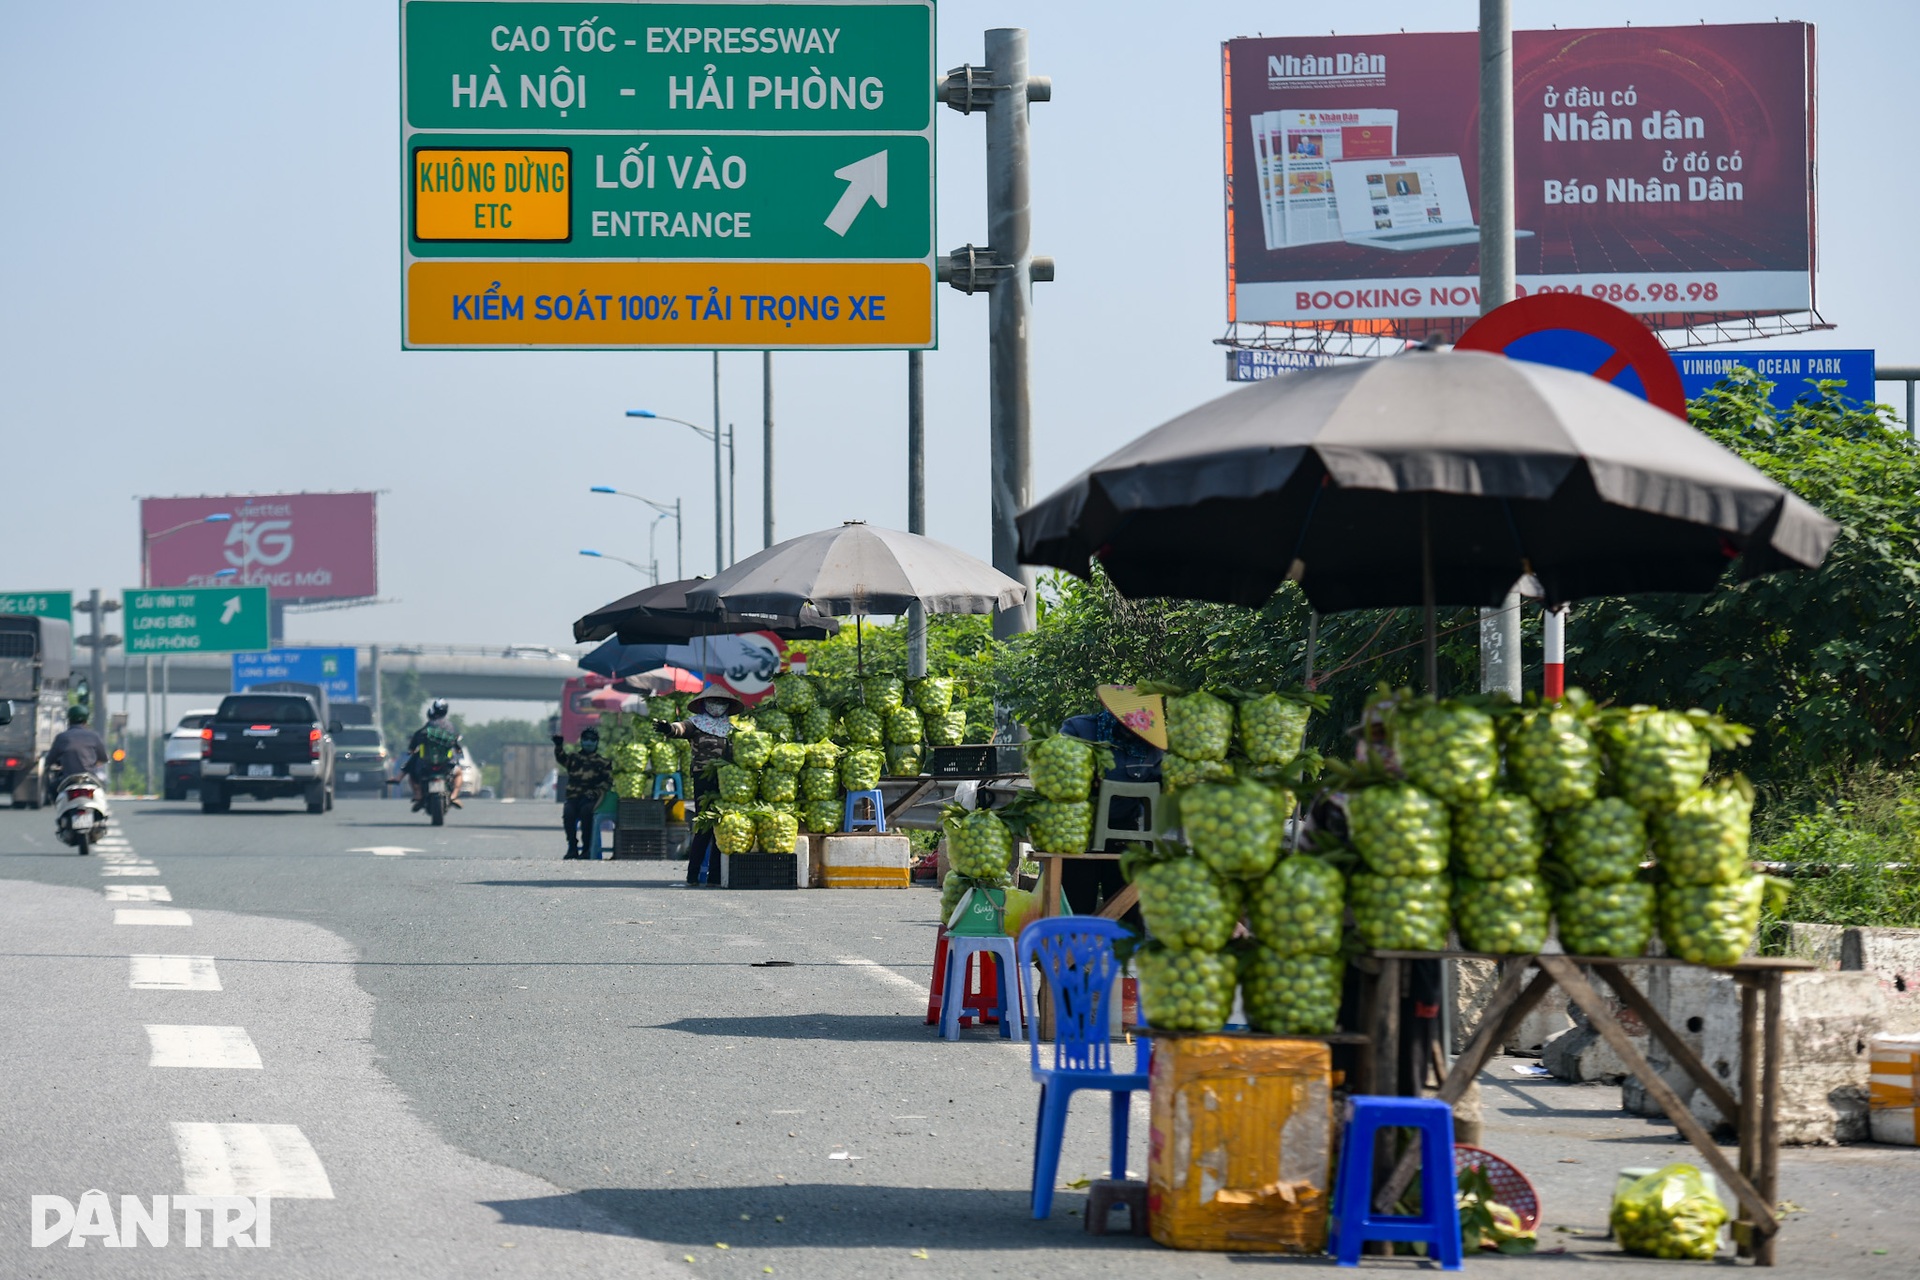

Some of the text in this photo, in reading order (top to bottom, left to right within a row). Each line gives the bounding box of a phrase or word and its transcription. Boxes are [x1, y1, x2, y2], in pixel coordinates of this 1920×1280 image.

[492, 25, 550, 52] CAO
[558, 16, 616, 52] TỐC
[647, 28, 841, 54] EXPRESSWAY
[1268, 52, 1386, 76] Nhân Dân
[453, 64, 884, 118] HÀ NỘI - HẢI PHÒNG
[1544, 85, 1638, 108] ở đâu có
[1543, 109, 1705, 142] Nhân dân
[421, 155, 565, 193] KHÔNG DỪNG
[595, 143, 747, 190] LỐI VÀO
[1662, 150, 1743, 172] ở đó có
[1543, 175, 1743, 204] Báo Nhân Dân
[474, 203, 513, 229] ETC
[592, 211, 751, 238] ENTRANCE
[453, 281, 886, 328] KIỂM SOÁT 100% TẢI TRỌNG XE
[1296, 288, 1422, 310] BOOKING
[1252, 351, 1334, 367] BIZMAN.VN
[1757, 358, 1801, 375] OCEAN
[1808, 358, 1842, 374] PARK
[235, 503, 292, 518] viettel
[223, 520, 293, 567] 5G
